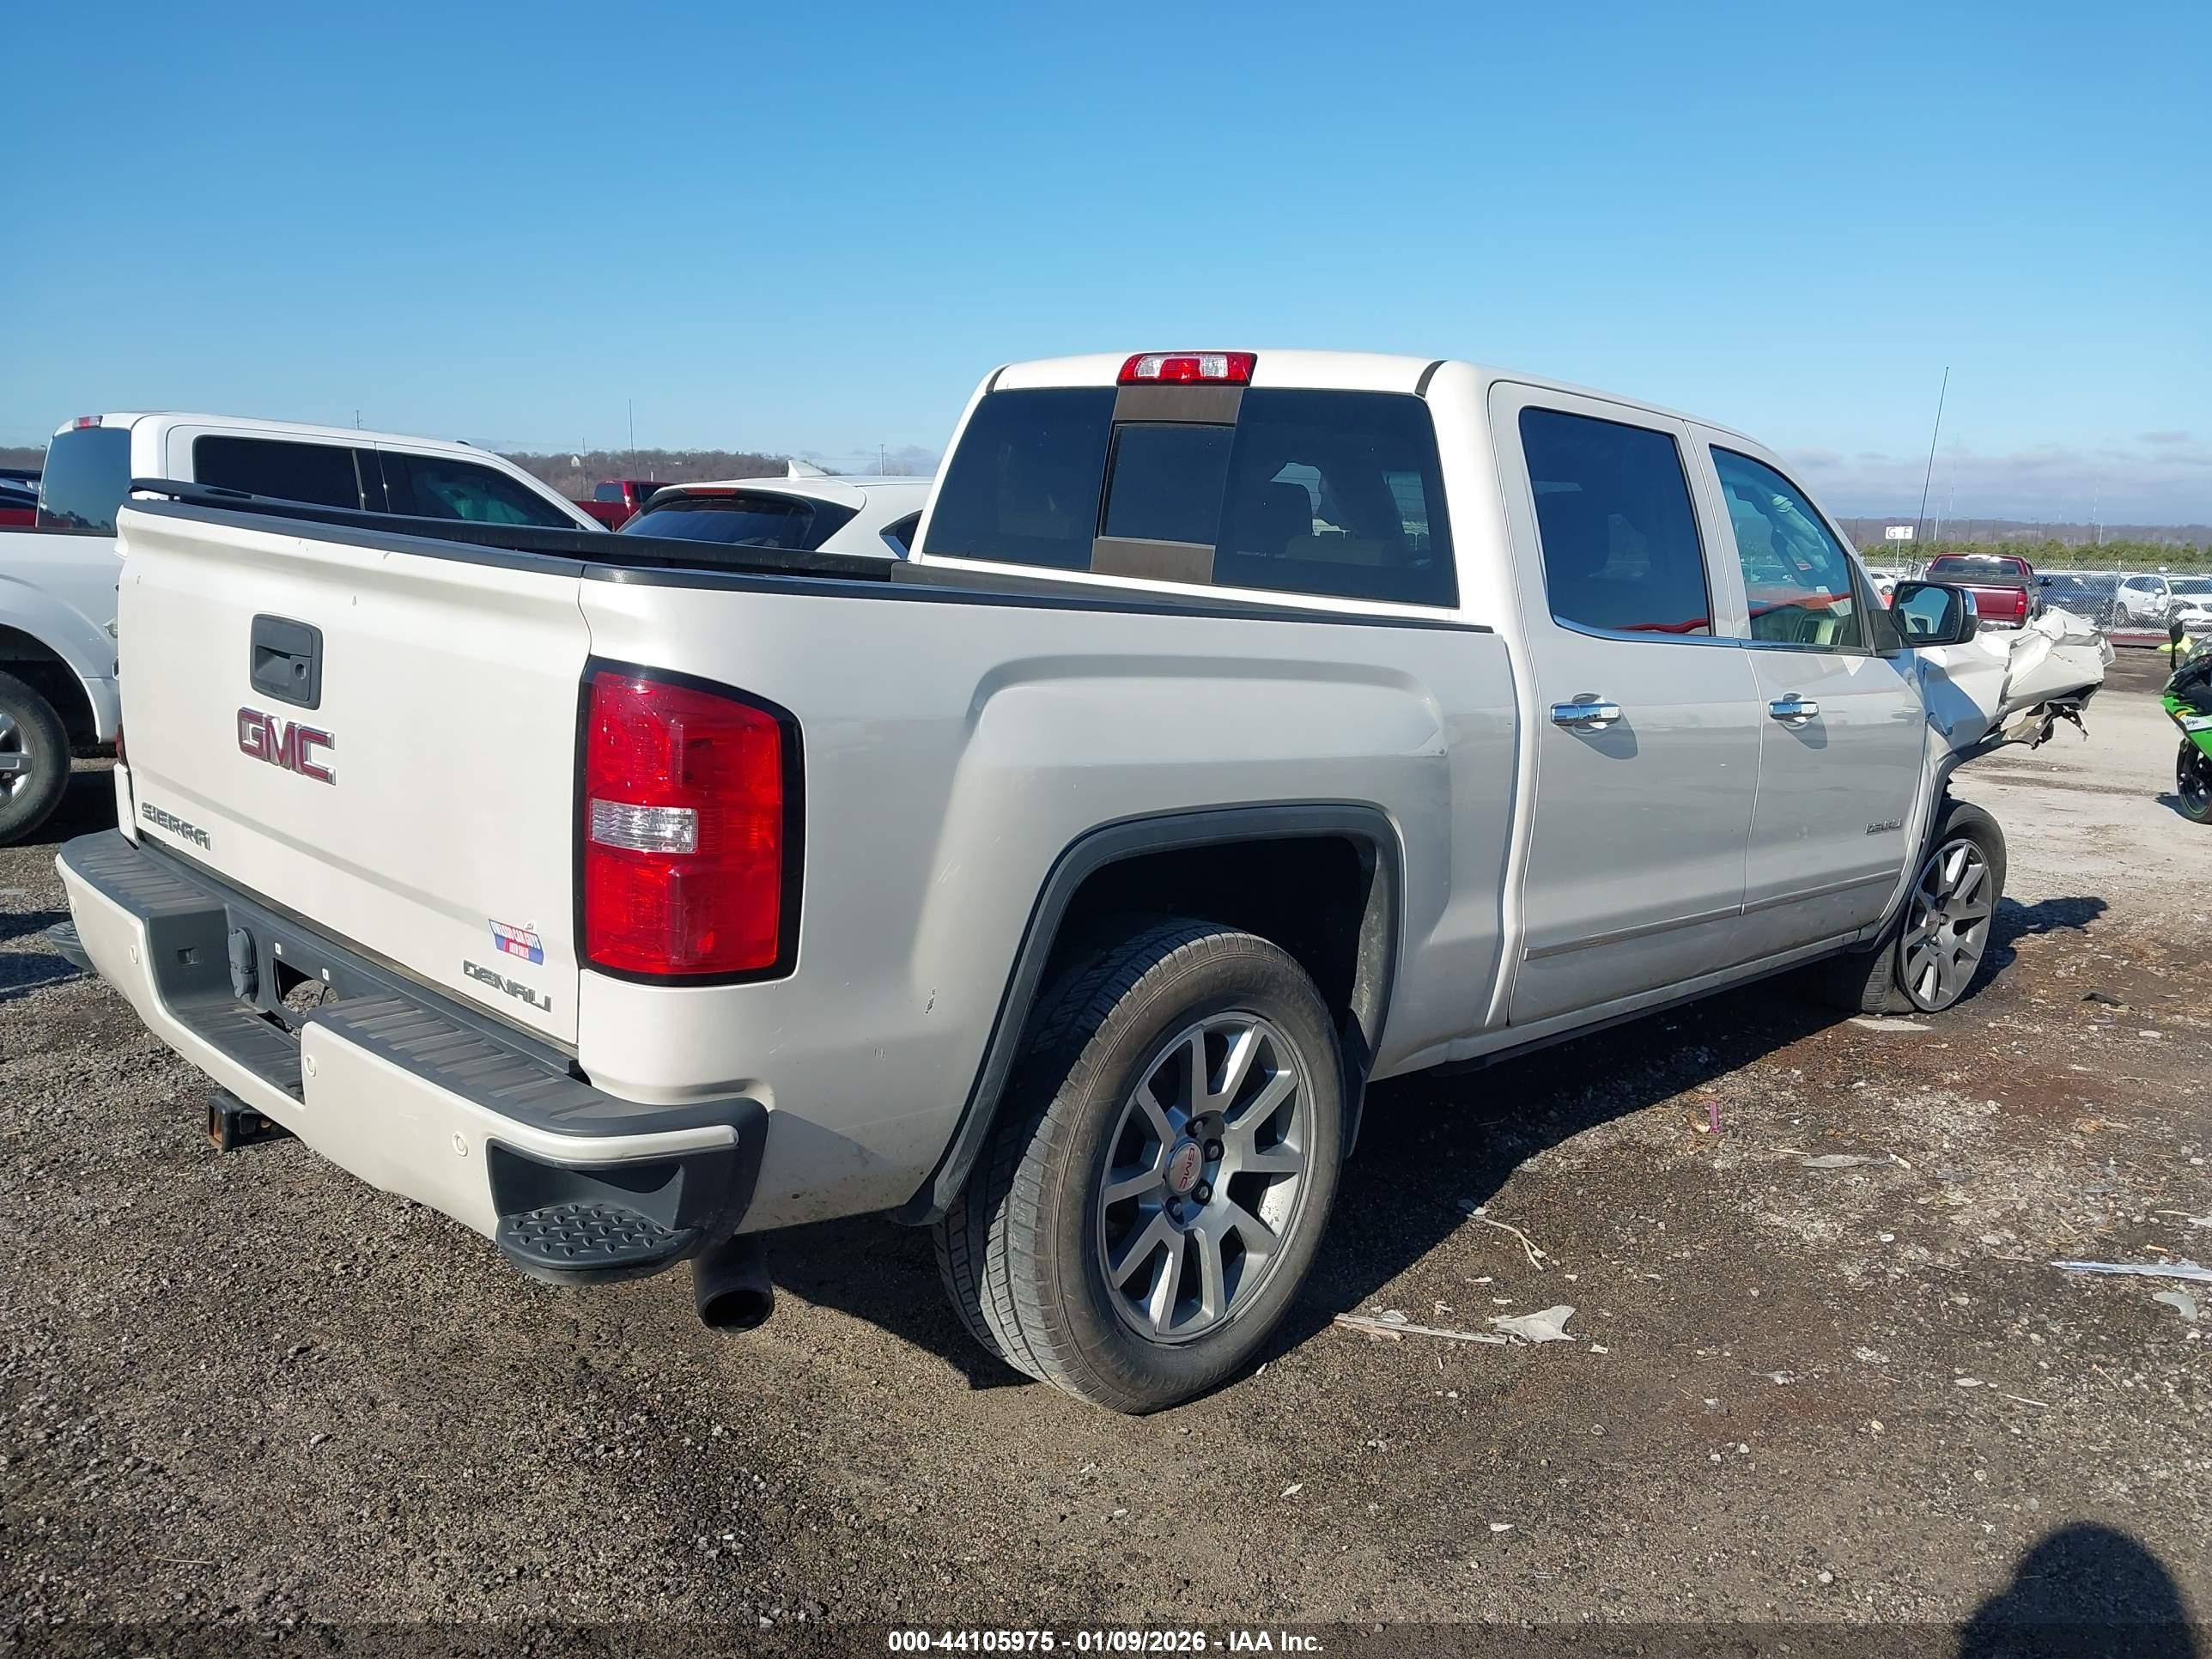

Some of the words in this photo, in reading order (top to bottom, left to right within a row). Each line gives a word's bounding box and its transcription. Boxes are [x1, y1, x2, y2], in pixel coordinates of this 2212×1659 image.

[1887, 527, 1896, 538] G
[1903, 527, 1910, 538] F
[237, 707, 337, 786] GMC
[142, 801, 211, 852] SIERRA
[463, 959, 552, 1013] DENALI
[1178, 1146, 1195, 1189] GMC
